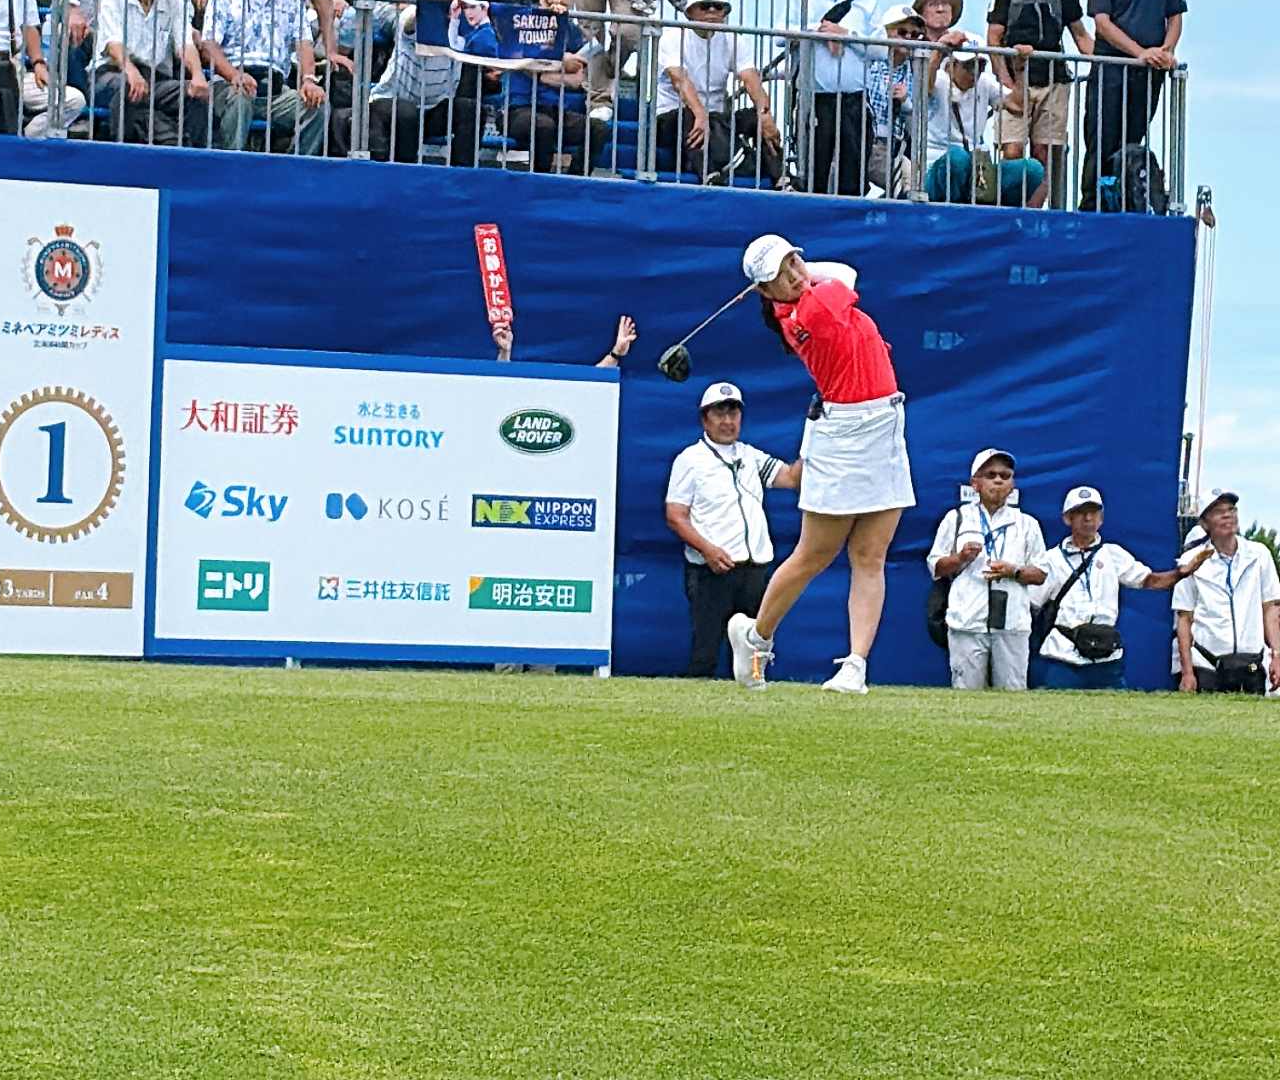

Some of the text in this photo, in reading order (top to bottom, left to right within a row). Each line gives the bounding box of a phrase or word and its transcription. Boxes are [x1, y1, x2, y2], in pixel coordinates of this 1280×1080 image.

[512, 14, 558, 30] SAKURA
[180, 399, 299, 435] 大和証券
[358, 401, 421, 420] 水と生きる
[334, 424, 445, 449] SUNTORY
[35, 421, 74, 504] 1
[221, 485, 289, 522] Sky
[377, 495, 449, 521] KOSÉ
[534, 501, 594, 516] NIPPON
[534, 514, 593, 528] EXPRESS
[96, 582, 109, 601] 4
[204, 570, 264, 599] ニトリ
[345, 579, 451, 602] 三井住友信託
[492, 583, 576, 607] 明治安田
